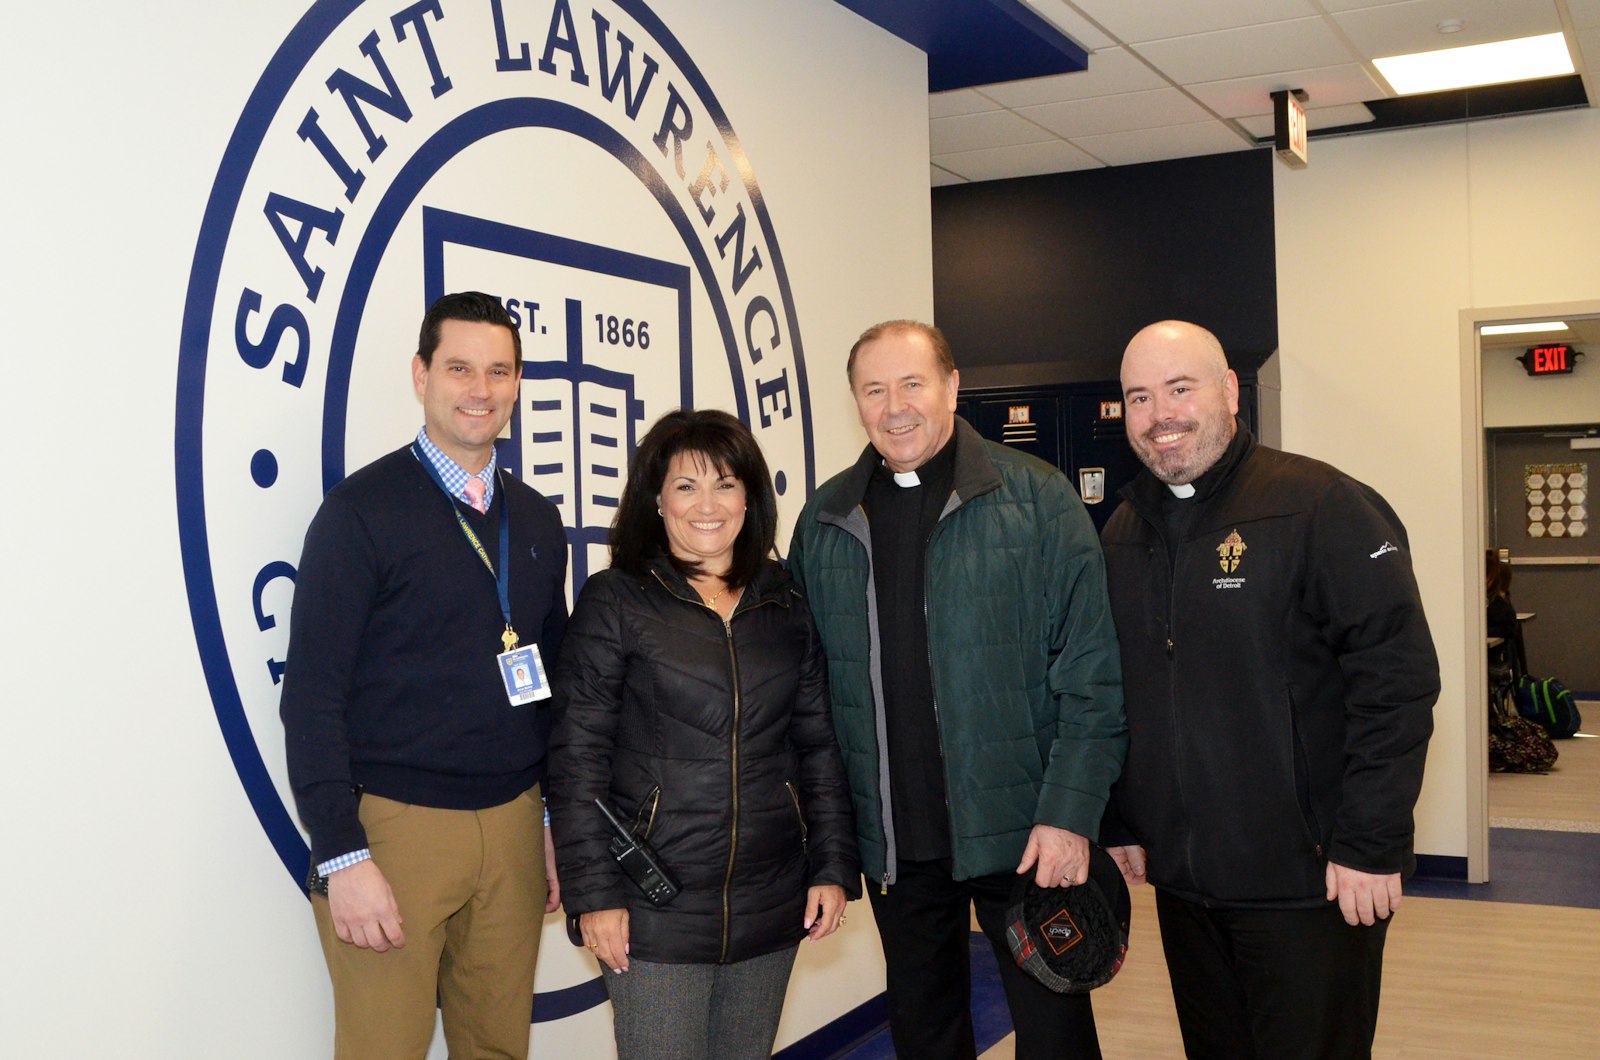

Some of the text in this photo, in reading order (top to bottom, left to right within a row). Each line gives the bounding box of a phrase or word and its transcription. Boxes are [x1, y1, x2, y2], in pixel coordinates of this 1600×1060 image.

[235, 0, 792, 429] SAINT LAWRENCE
[493, 296, 650, 349] ST. 1866
[1534, 346, 1567, 372] EXIT
[460, 518, 481, 549] LAWRENCE
